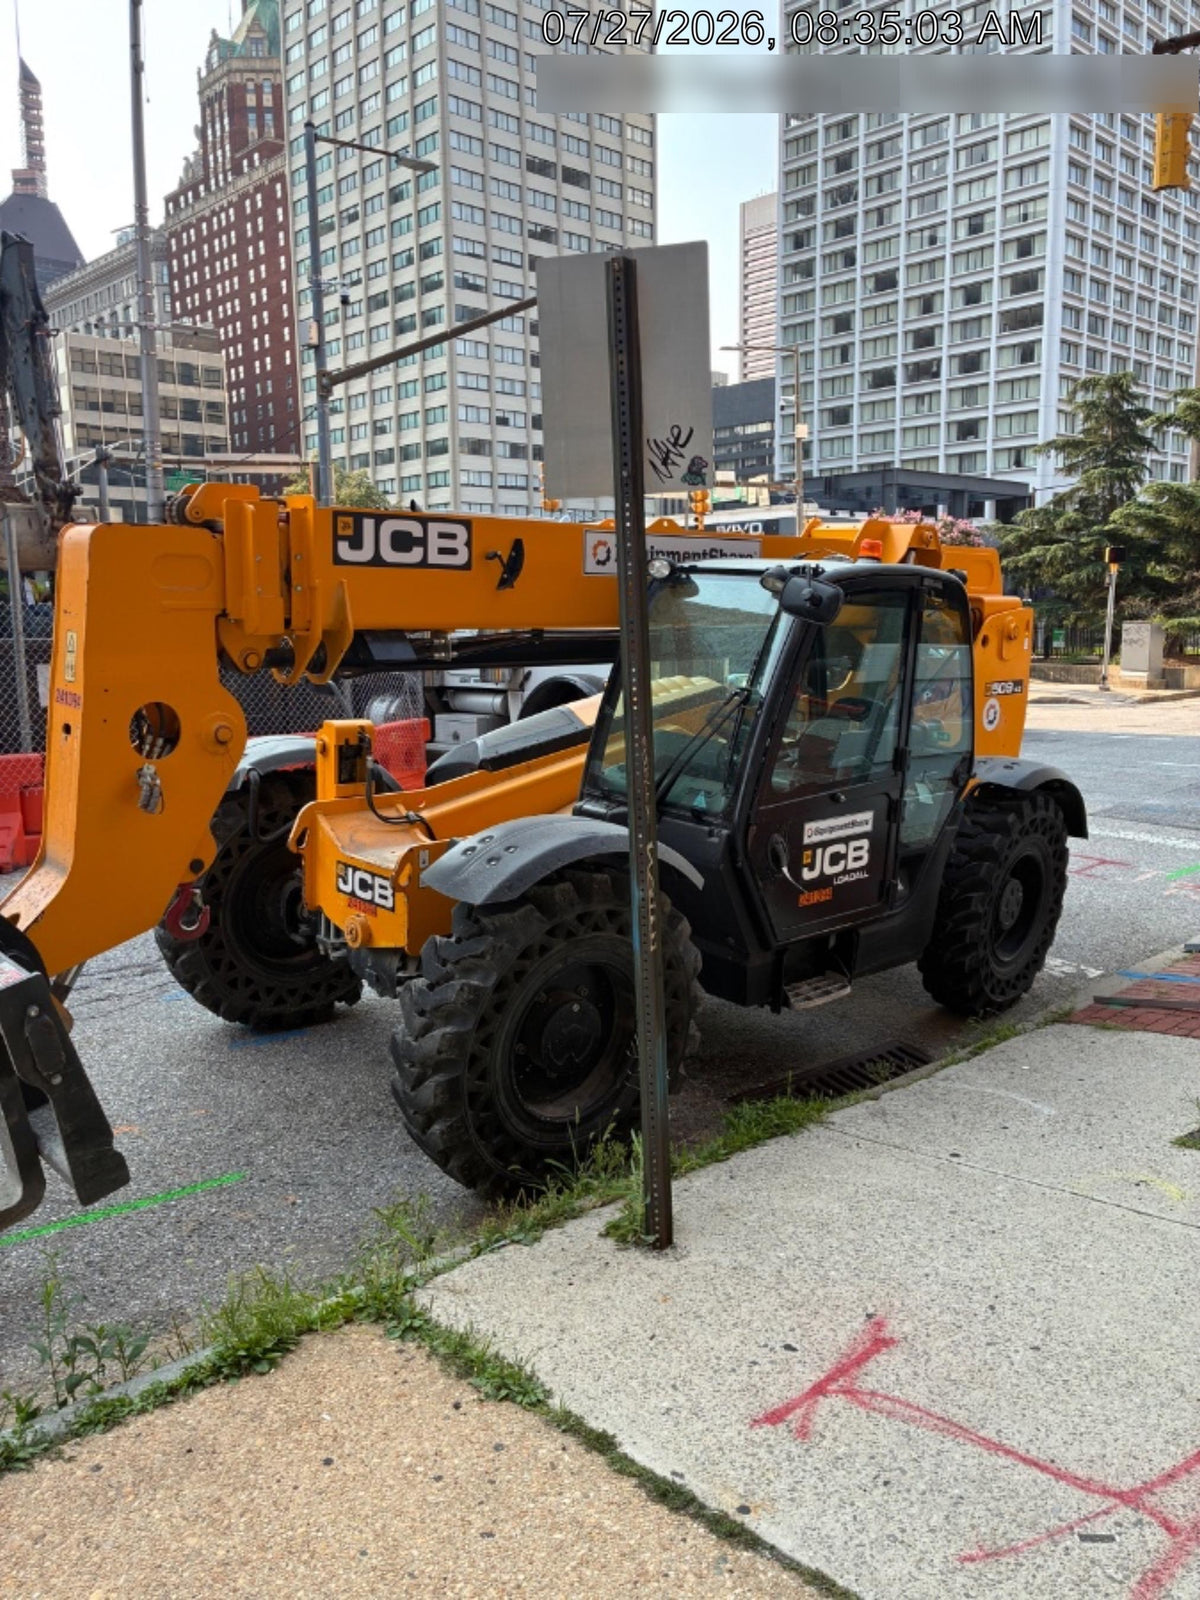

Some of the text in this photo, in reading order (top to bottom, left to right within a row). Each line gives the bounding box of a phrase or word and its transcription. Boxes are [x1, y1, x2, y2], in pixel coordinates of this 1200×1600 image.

[337, 517, 469, 566] JCB
[802, 838, 869, 880] JCB
[833, 870, 869, 885] LOADALL
[338, 866, 393, 908] JCB
